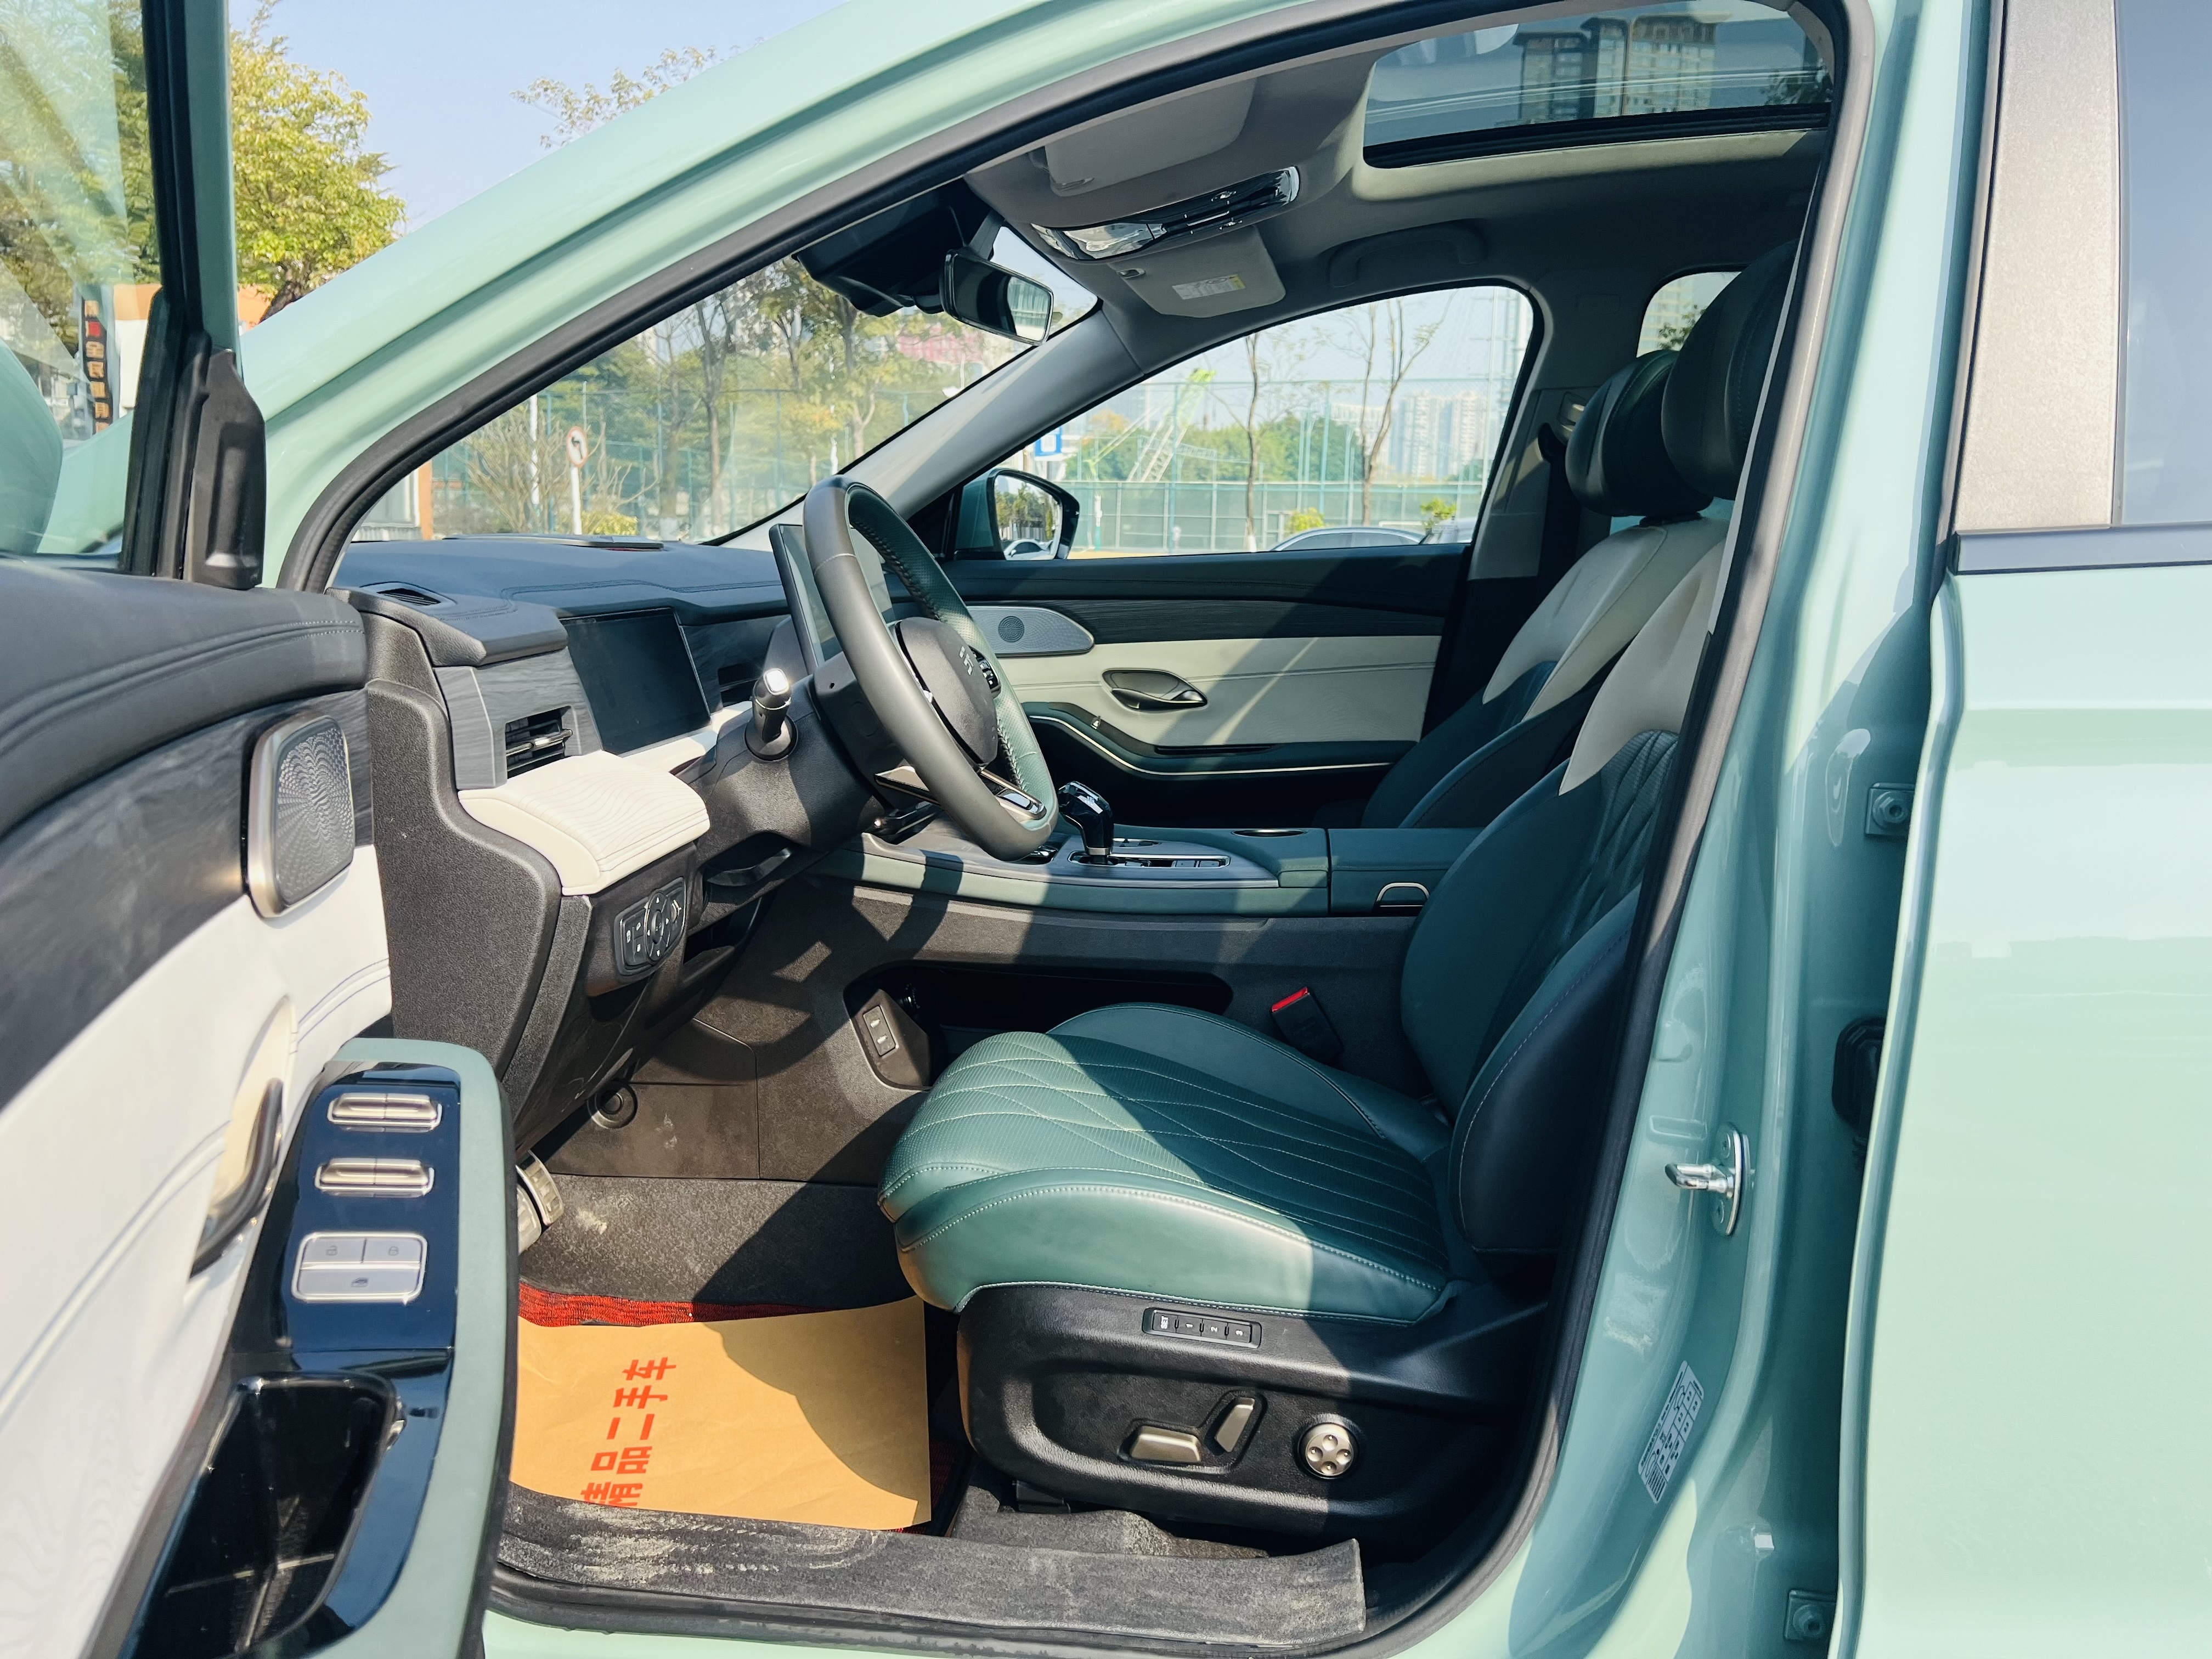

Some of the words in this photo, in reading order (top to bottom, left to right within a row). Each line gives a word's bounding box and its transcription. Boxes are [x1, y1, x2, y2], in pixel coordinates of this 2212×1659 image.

[1160, 1315, 1169, 1329] SET
[580, 1357, 676, 1507] 精品二手车
